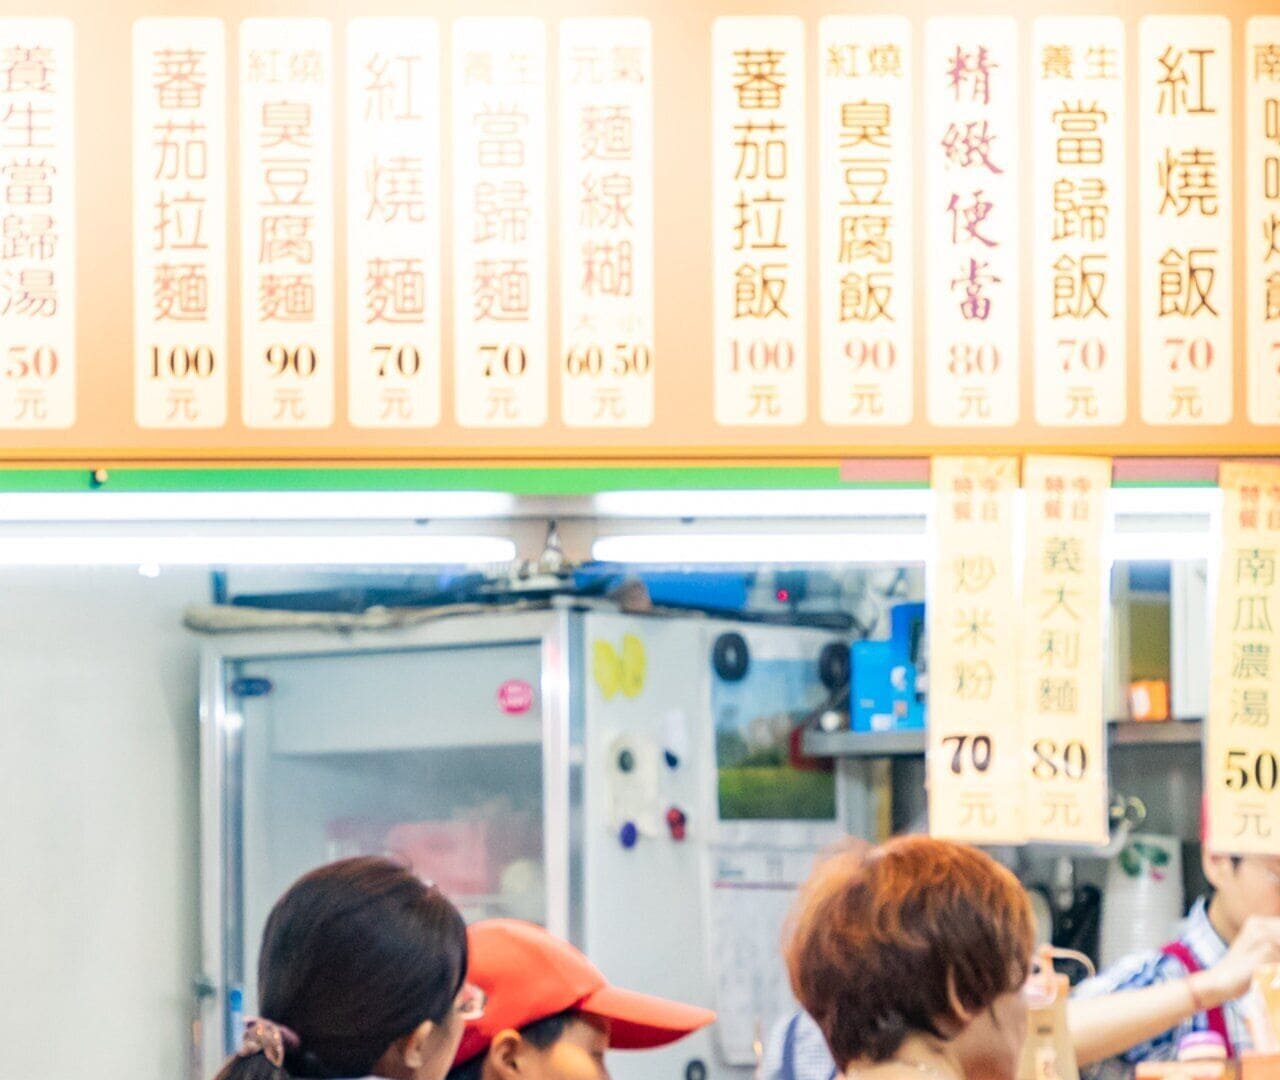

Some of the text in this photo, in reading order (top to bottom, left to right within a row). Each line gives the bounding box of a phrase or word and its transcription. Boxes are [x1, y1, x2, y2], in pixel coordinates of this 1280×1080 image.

[1042, 44, 1117, 80] 養生
[0, 45, 60, 321] 養生當歸湯
[153, 48, 208, 323] 蕃茄拉麵
[365, 50, 426, 325] 紅燒麵
[732, 49, 789, 321] 蕃茄拉飯
[942, 46, 1003, 321] 精緻便當
[1157, 44, 1218, 319] 紅燒飯
[258, 100, 316, 323] 臭豆腐麵
[473, 100, 531, 323] 當歸麵
[581, 105, 634, 298] 麵線糊
[839, 98, 894, 322] 臭豆腐飯
[1051, 99, 1108, 320] 當歸飯
[6, 345, 59, 378] 50
[150, 345, 215, 378] 100
[266, 345, 317, 378] 90
[373, 345, 420, 377] 70
[480, 345, 527, 377] 70
[566, 345, 650, 377] 60 50
[729, 339, 794, 372] 100
[845, 339, 896, 372] 90
[948, 344, 1001, 375] 80
[1058, 339, 1105, 371] 70
[1164, 339, 1213, 371] 70
[166, 388, 198, 420] 元
[274, 388, 306, 420] 元
[380, 388, 415, 420] 元
[486, 388, 519, 420] 元
[747, 385, 780, 417] 元
[851, 386, 884, 416] 元
[1066, 386, 1098, 417] 元
[1171, 386, 1202, 417] 元
[953, 554, 996, 701] 炒米粉
[1039, 536, 1083, 715] 義大利麵
[1231, 549, 1276, 729] 南瓜濃湯
[941, 734, 993, 774] 70
[1032, 740, 1087, 781] 80
[1225, 751, 1279, 792] 50
[1234, 805, 1272, 839] 元
